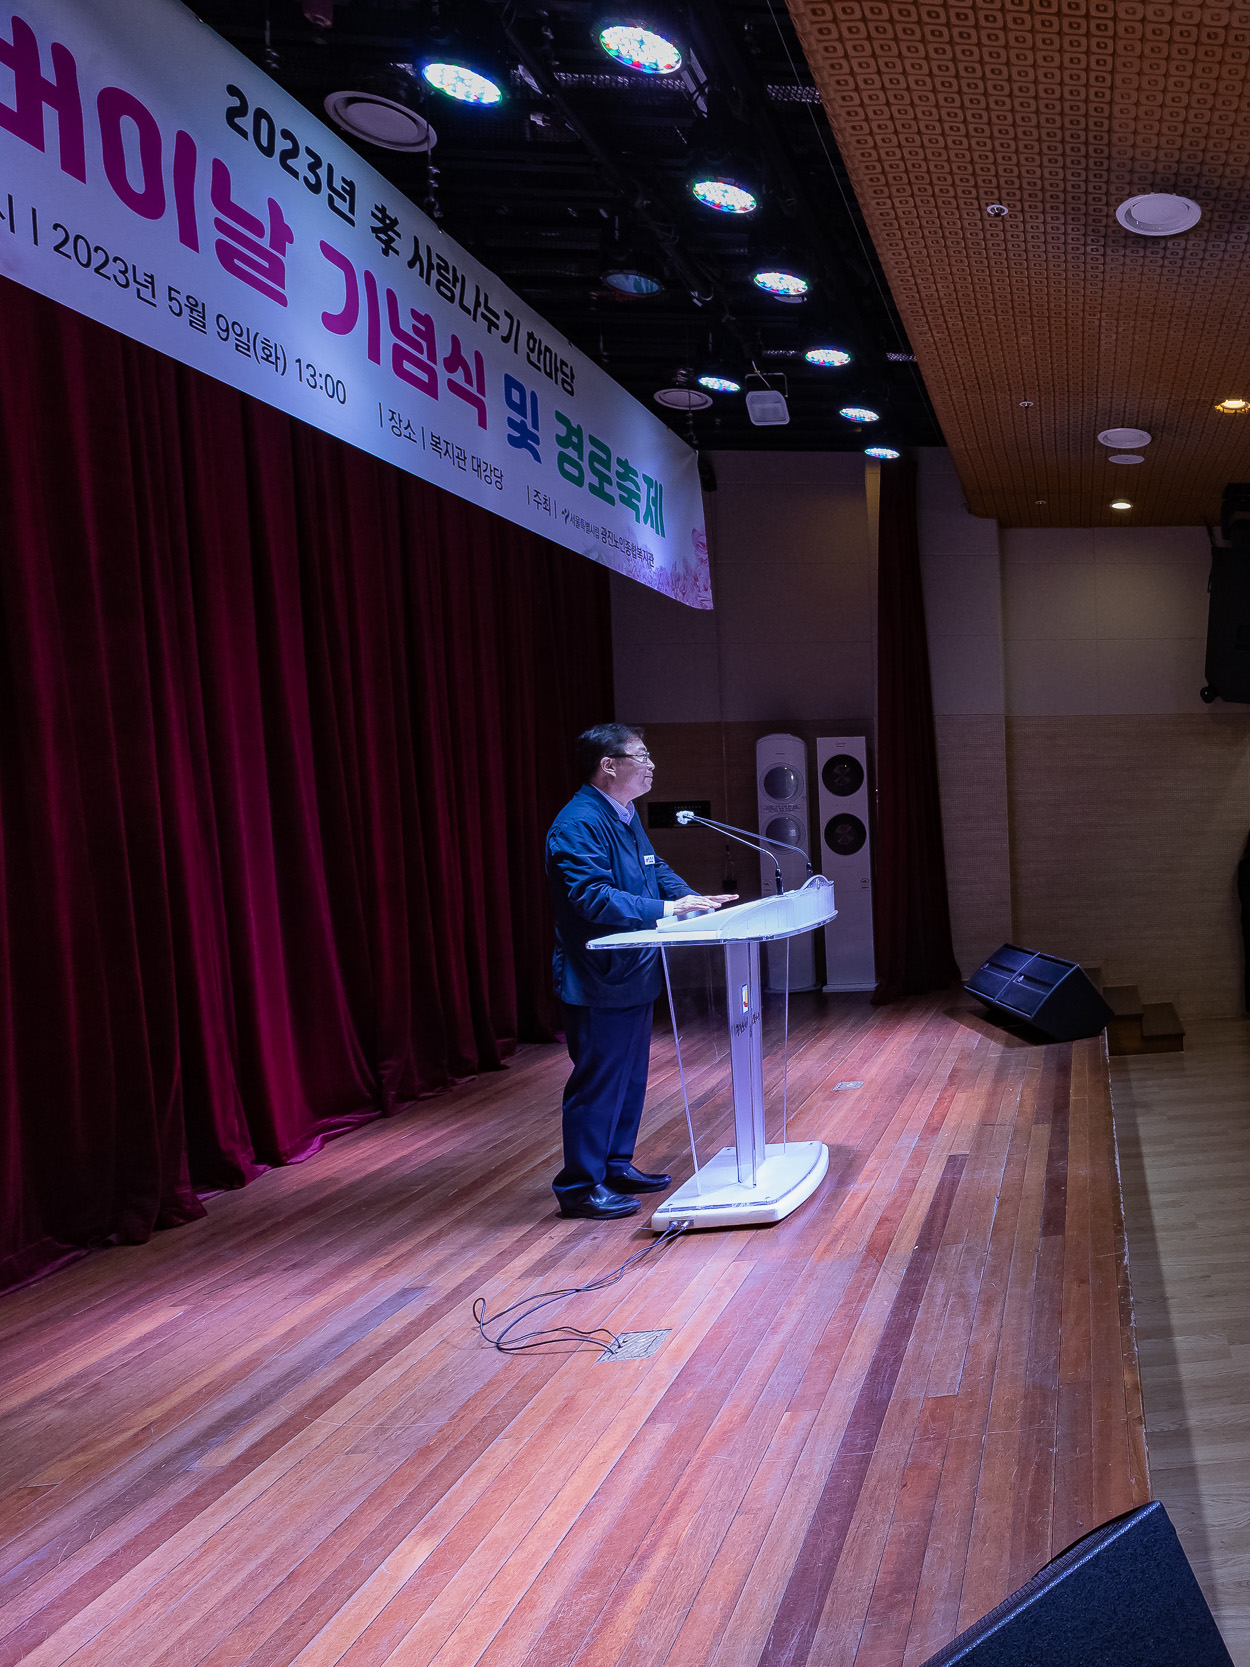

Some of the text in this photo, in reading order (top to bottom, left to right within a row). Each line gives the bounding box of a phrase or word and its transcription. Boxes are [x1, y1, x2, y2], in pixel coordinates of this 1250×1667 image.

[52, 222, 347, 404] 2023년 5월 9일(화) 13:00
[225, 84, 576, 398] 2023년 孝 사랑나누기 한마당
[319, 239, 488, 431] 기념식
[503, 373, 543, 464] 및
[554, 409, 666, 539] 경로축제
[388, 409, 504, 491] 장소 복지관 대강당
[533, 488, 655, 569] 주최 서울특별시립 광진노인종합복지관
